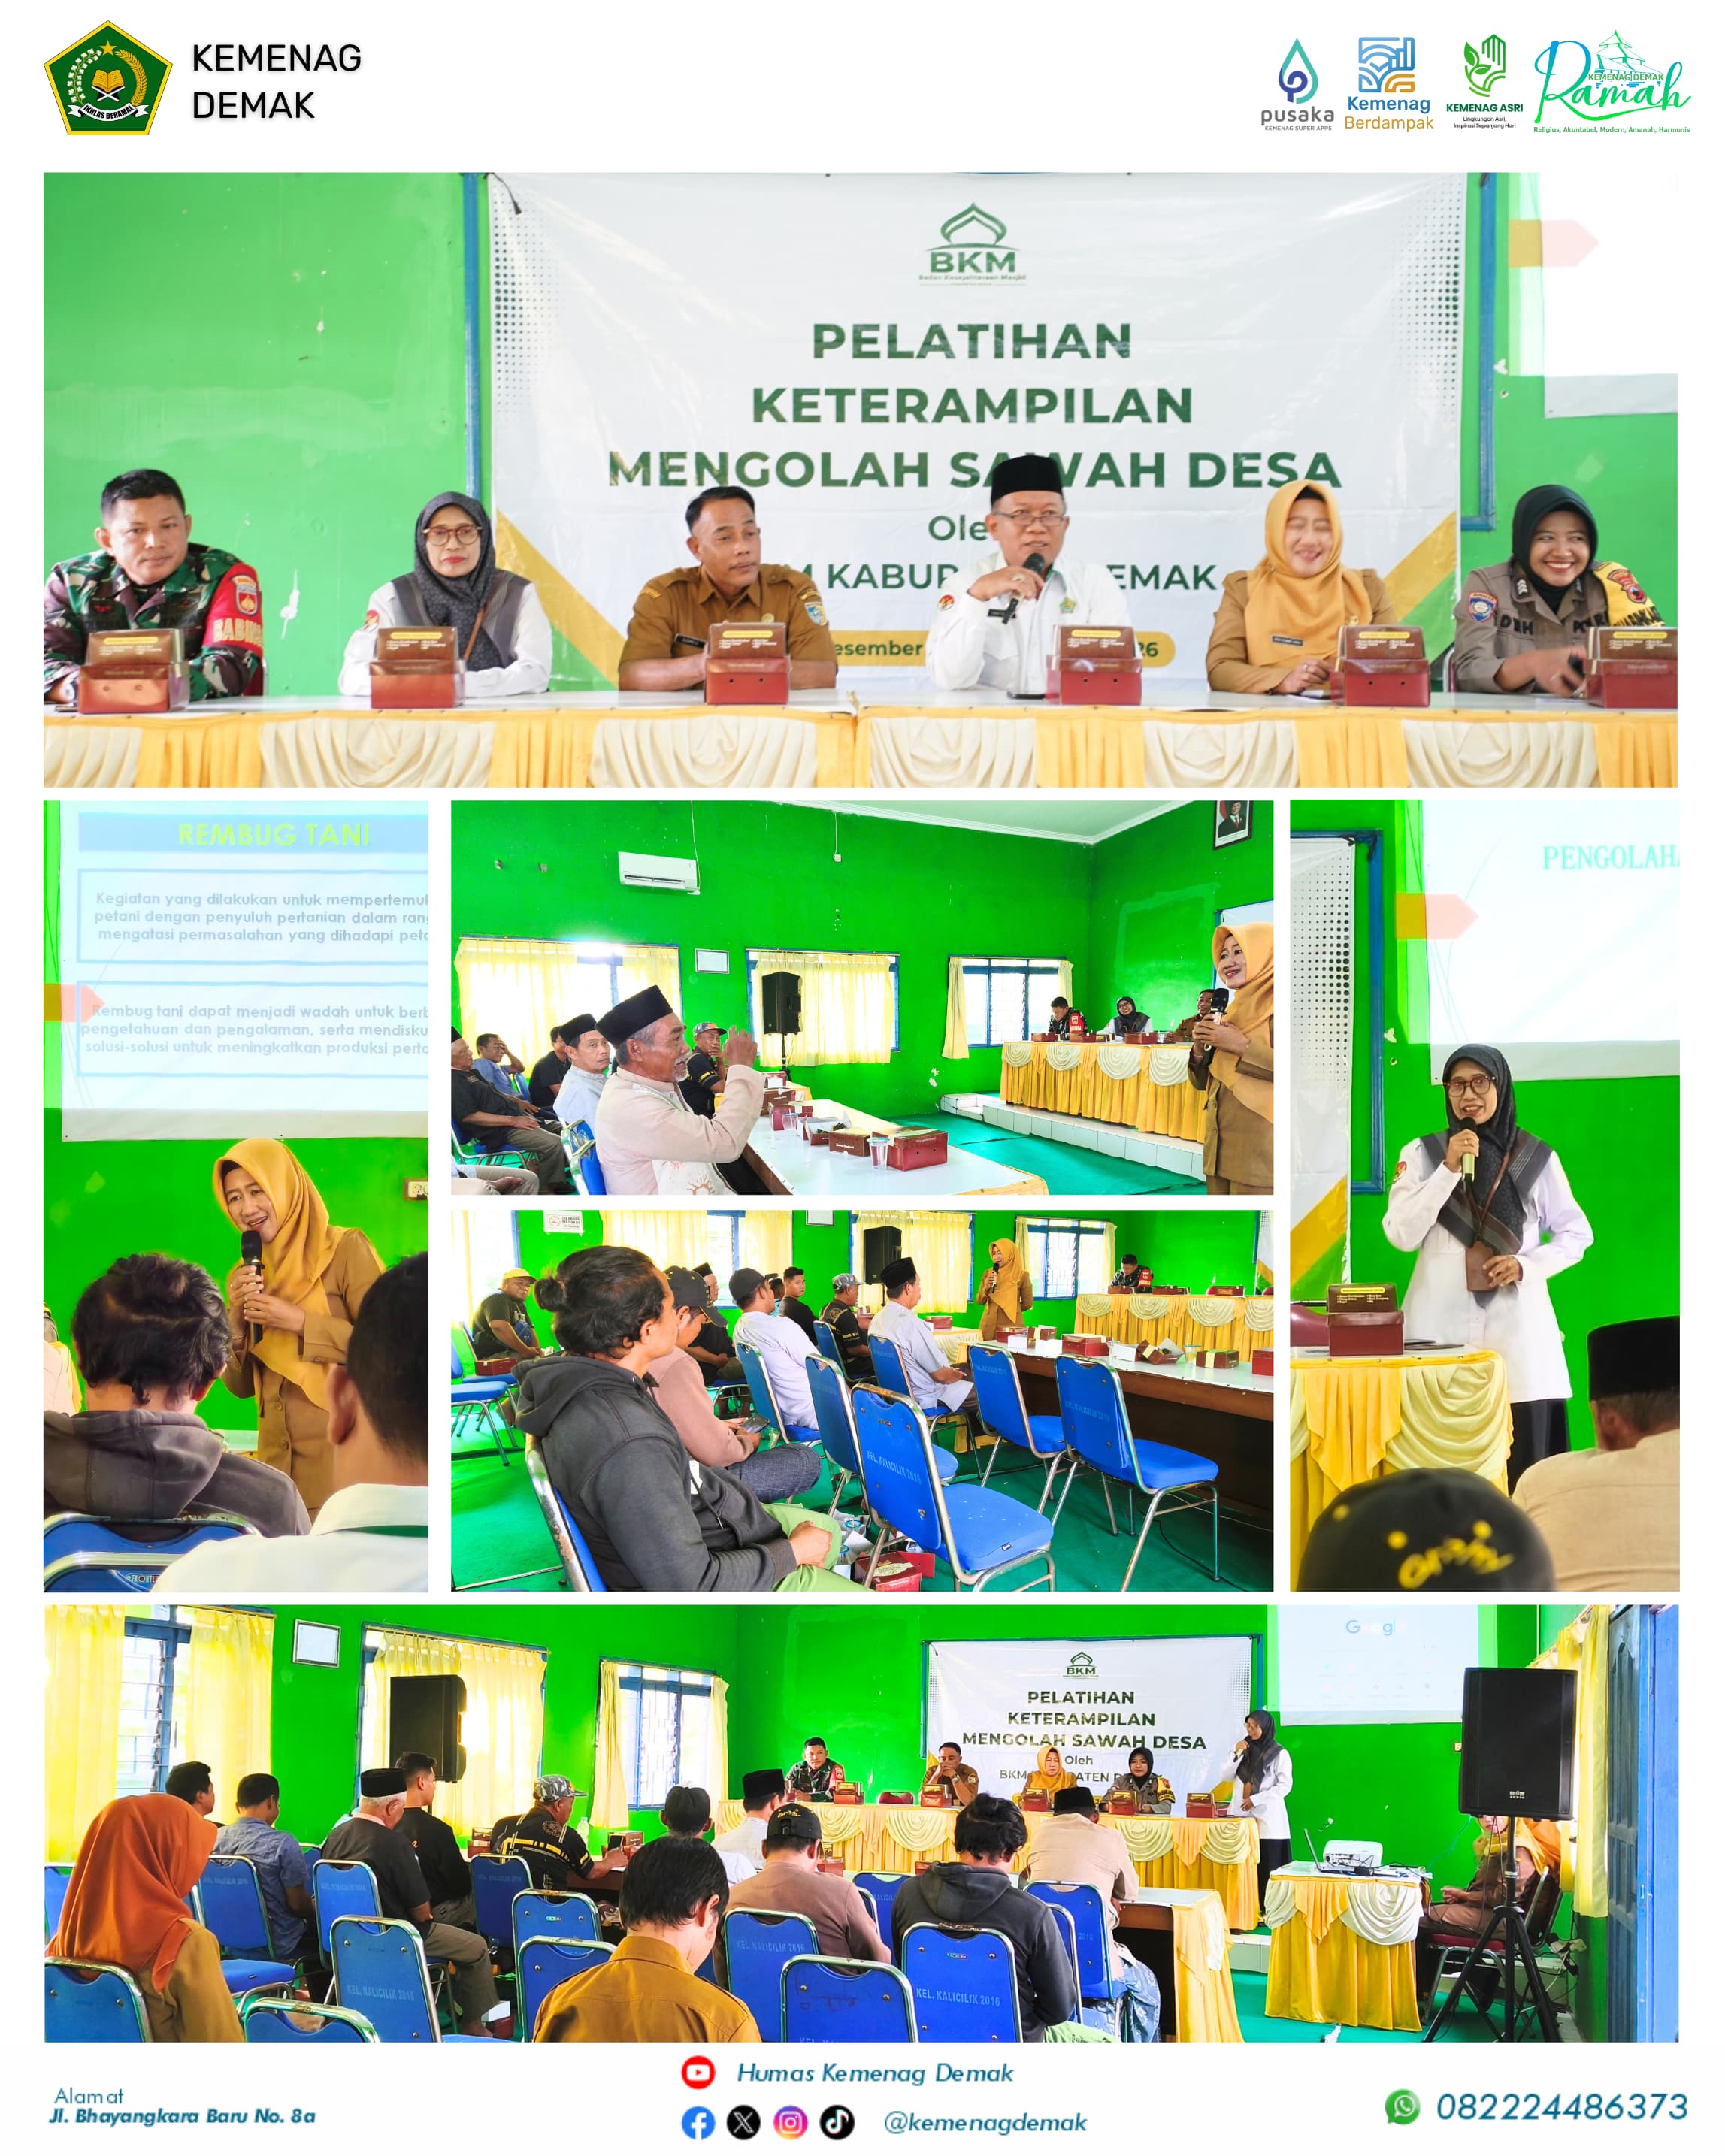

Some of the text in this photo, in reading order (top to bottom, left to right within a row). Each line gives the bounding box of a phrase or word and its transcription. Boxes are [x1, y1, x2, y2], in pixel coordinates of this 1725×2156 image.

[931, 252, 1015, 272] BKM
[814, 324, 1130, 358] PELATIHAN
[754, 388, 1191, 423] KETERAMPILAN
[609, 452, 928, 488] MENGOLAH
[1189, 452, 1341, 488] DESA
[928, 515, 989, 541] Ole
[828, 564, 957, 589] KABUP
[1105, 564, 1217, 590] EMAK
[836, 640, 923, 656] esember
[180, 824, 368, 846] REMBUG TANI
[1543, 844, 1679, 871] PENGOLAH
[97, 892, 160, 906] Kegiatan
[165, 896, 201, 907] yang
[207, 893, 277, 905] dilakukan
[283, 894, 322, 906] untuk
[95, 910, 140, 924] petani
[145, 910, 200, 925] dengan
[207, 911, 271, 925] penyuluh
[278, 911, 345, 926] pertanian
[352, 912, 396, 924] dalam
[99, 928, 174, 942] mengatasi
[179, 929, 282, 942] permasalahan
[289, 932, 325, 943] yang
[331, 930, 393, 944] dihadapi
[92, 1003, 152, 1019] Rembug
[156, 1005, 183, 1017] tani
[189, 1005, 231, 1019] dapat
[237, 1005, 295, 1020] menjadi
[301, 1005, 349, 1018] wadah
[355, 1005, 394, 1018] untuk
[80, 1021, 178, 1038] pengetahuan
[184, 1024, 211, 1034] dan
[217, 1024, 313, 1038] pengalaman,
[320, 1024, 354, 1036] serta
[86, 1040, 168, 1052] solusi-solusi
[173, 1040, 212, 1053] untuk
[218, 1041, 321, 1056] meningkatkan
[327, 1041, 387, 1056] produksi
[1067, 1667, 1096, 1675] BKM
[1028, 1692, 1134, 1704] PELATIHAN
[1009, 1713, 1155, 1726] KETERAMPILAN
[963, 1732, 1206, 1749] MENGOLAH SAWAH DESA
[1065, 1755, 1093, 1764] Oleh
[1000, 1770, 1027, 1780] BKM
[916, 1988, 1000, 2007] KEL. KALICILIK 2016
